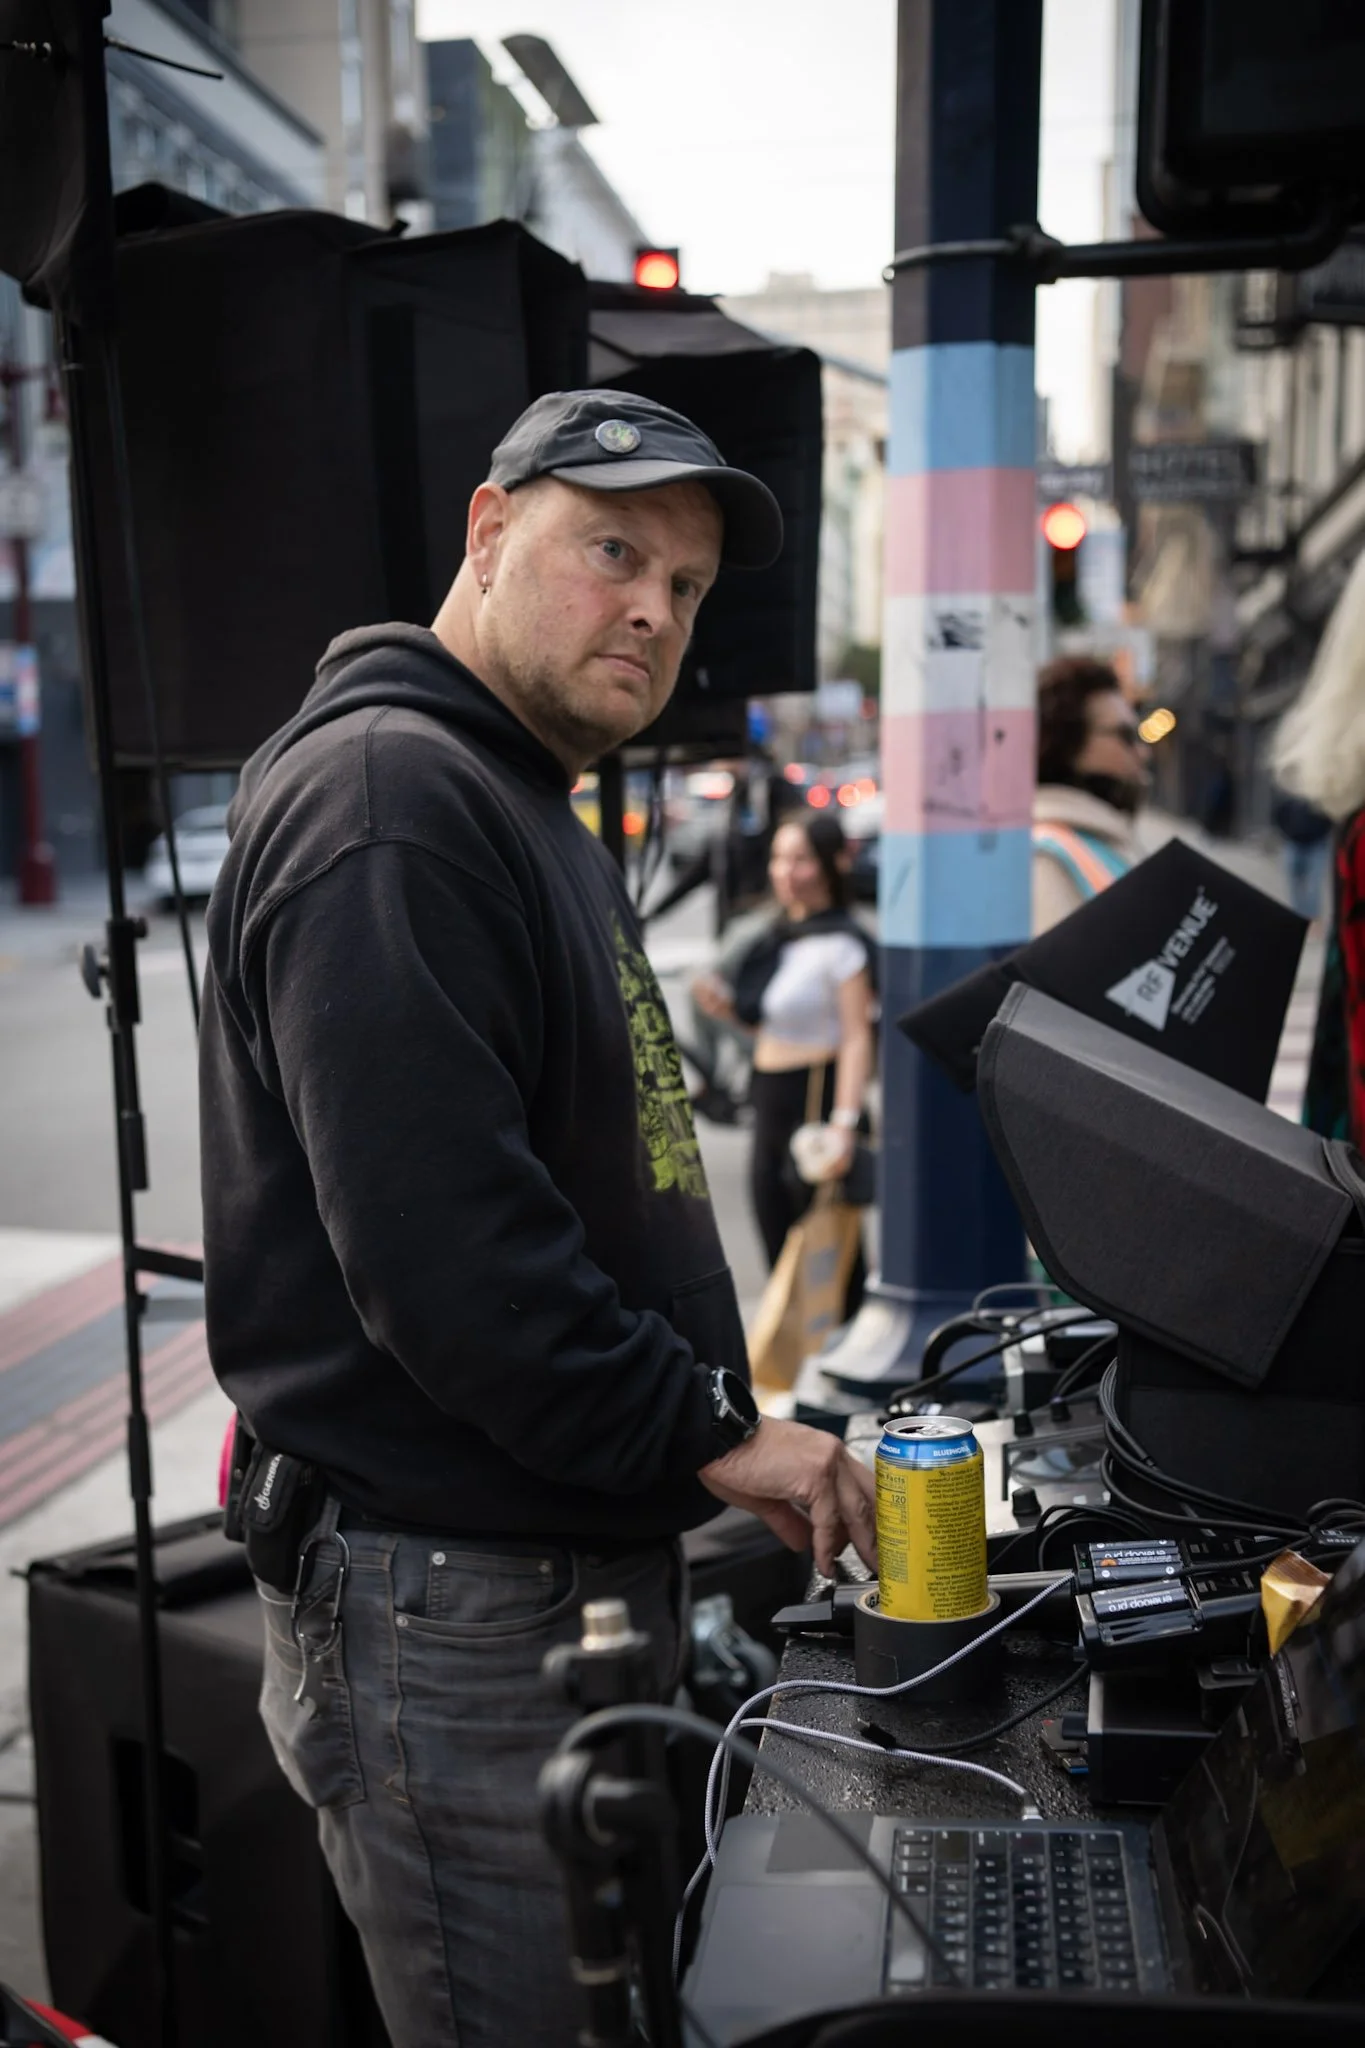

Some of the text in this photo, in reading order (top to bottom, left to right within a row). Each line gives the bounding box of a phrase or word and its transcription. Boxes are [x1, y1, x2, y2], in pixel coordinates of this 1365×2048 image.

[1136, 969, 1163, 1002] RF
[1157, 896, 1218, 967] VENUE
[890, 1494, 907, 1505] 120
[1108, 1599, 1128, 1612] pro
[1129, 1595, 1173, 1609] eneloop
